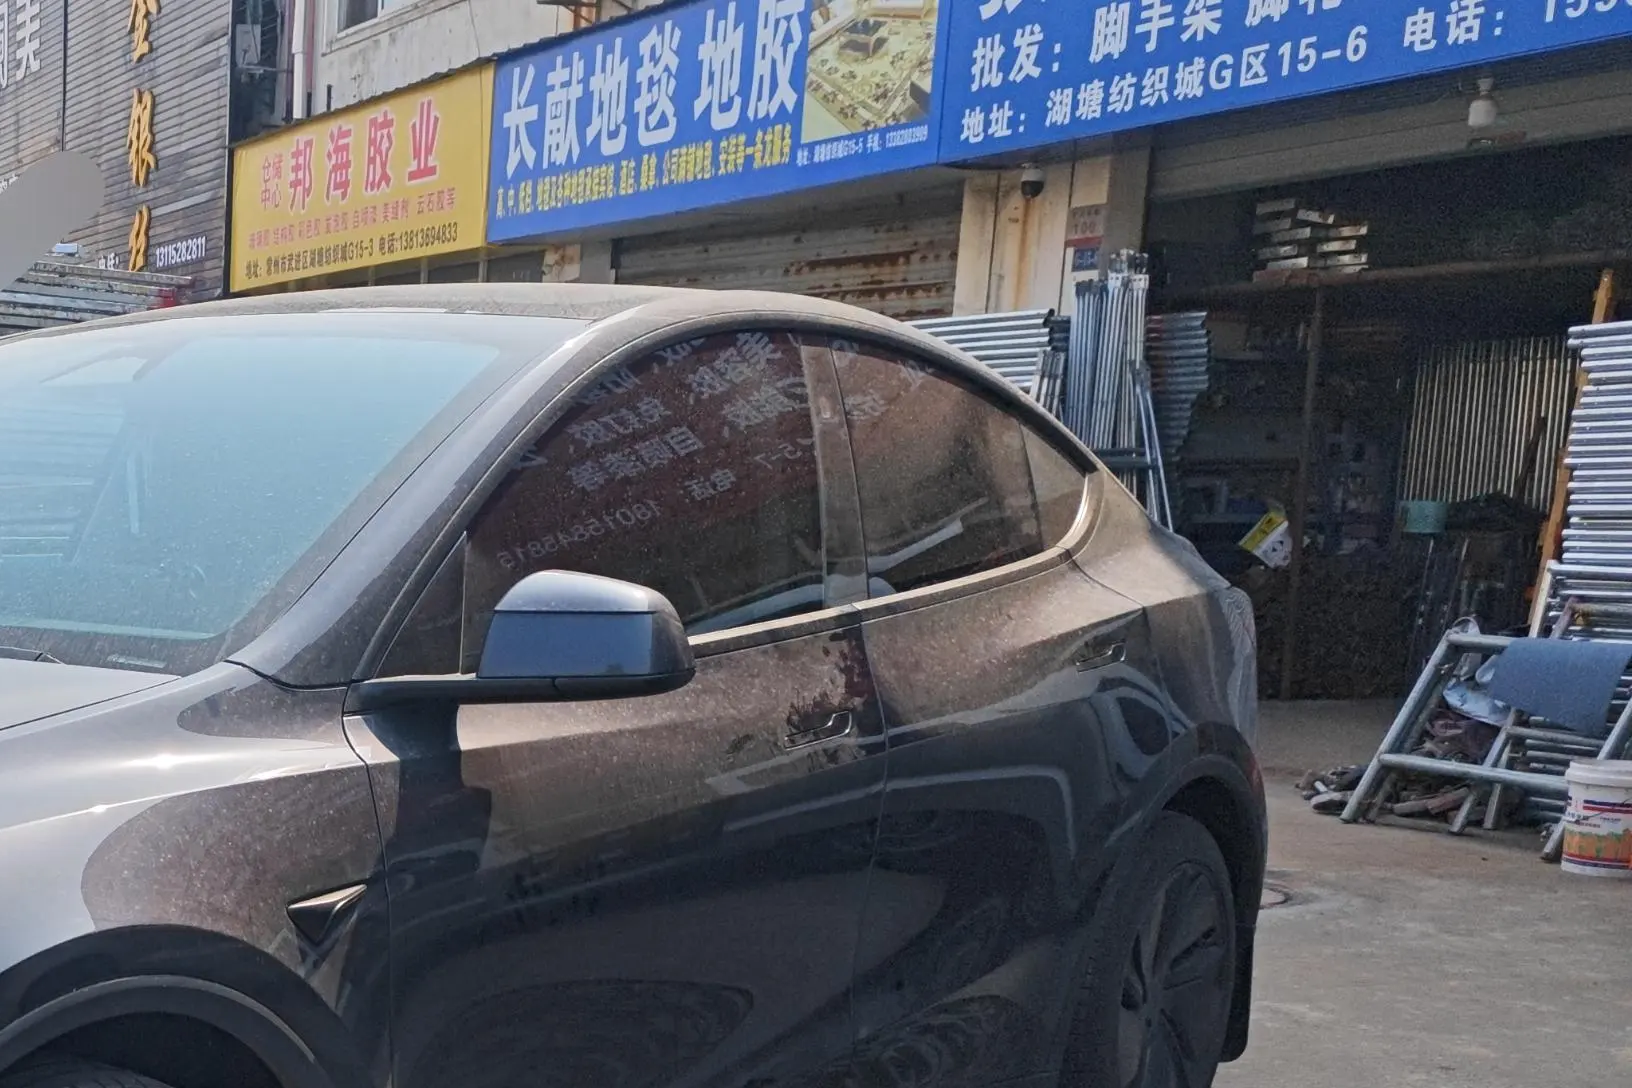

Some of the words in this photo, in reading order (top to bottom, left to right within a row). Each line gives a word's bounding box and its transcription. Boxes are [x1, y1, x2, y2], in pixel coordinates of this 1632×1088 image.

[503, 20, 682, 179] 长献地毯
[694, 0, 806, 130] 地胶
[260, 183, 282, 210] 中心
[288, 98, 440, 212] 邦海胶业
